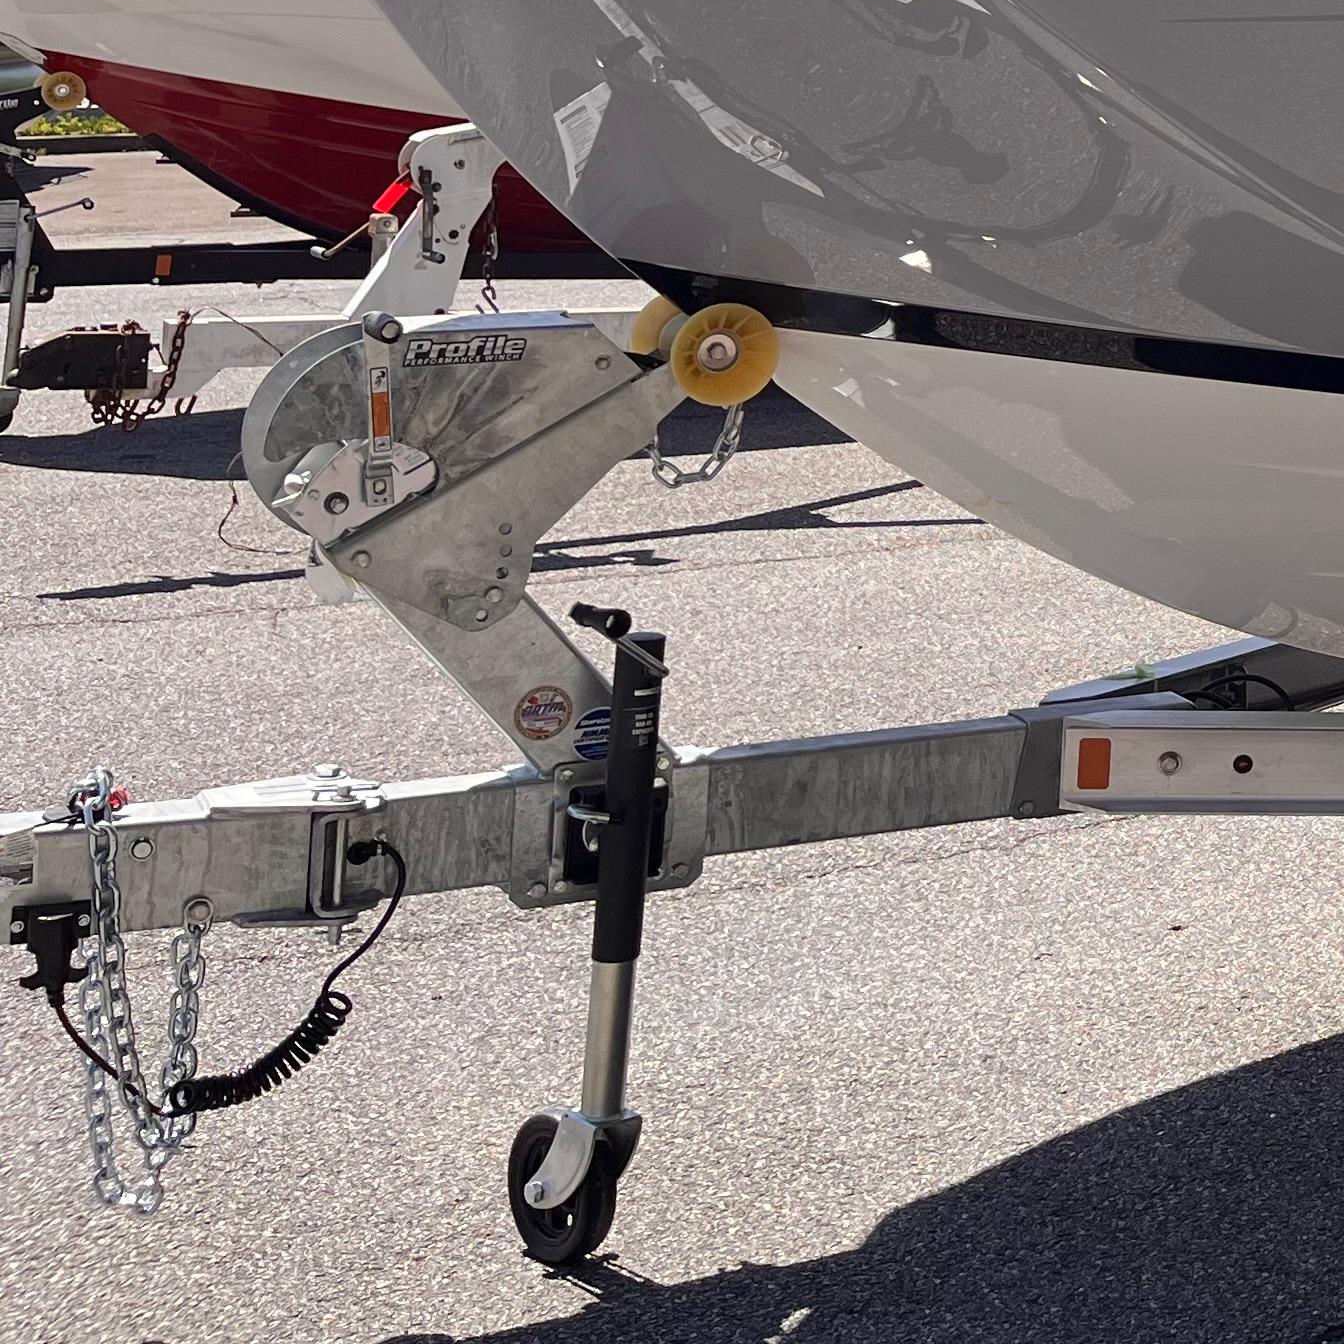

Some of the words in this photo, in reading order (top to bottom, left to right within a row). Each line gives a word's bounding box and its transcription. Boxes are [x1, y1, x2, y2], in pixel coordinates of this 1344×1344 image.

[405, 336, 526, 360] Profile
[404, 355, 480, 366] PERFORMANCE
[484, 353, 521, 362] WINCH
